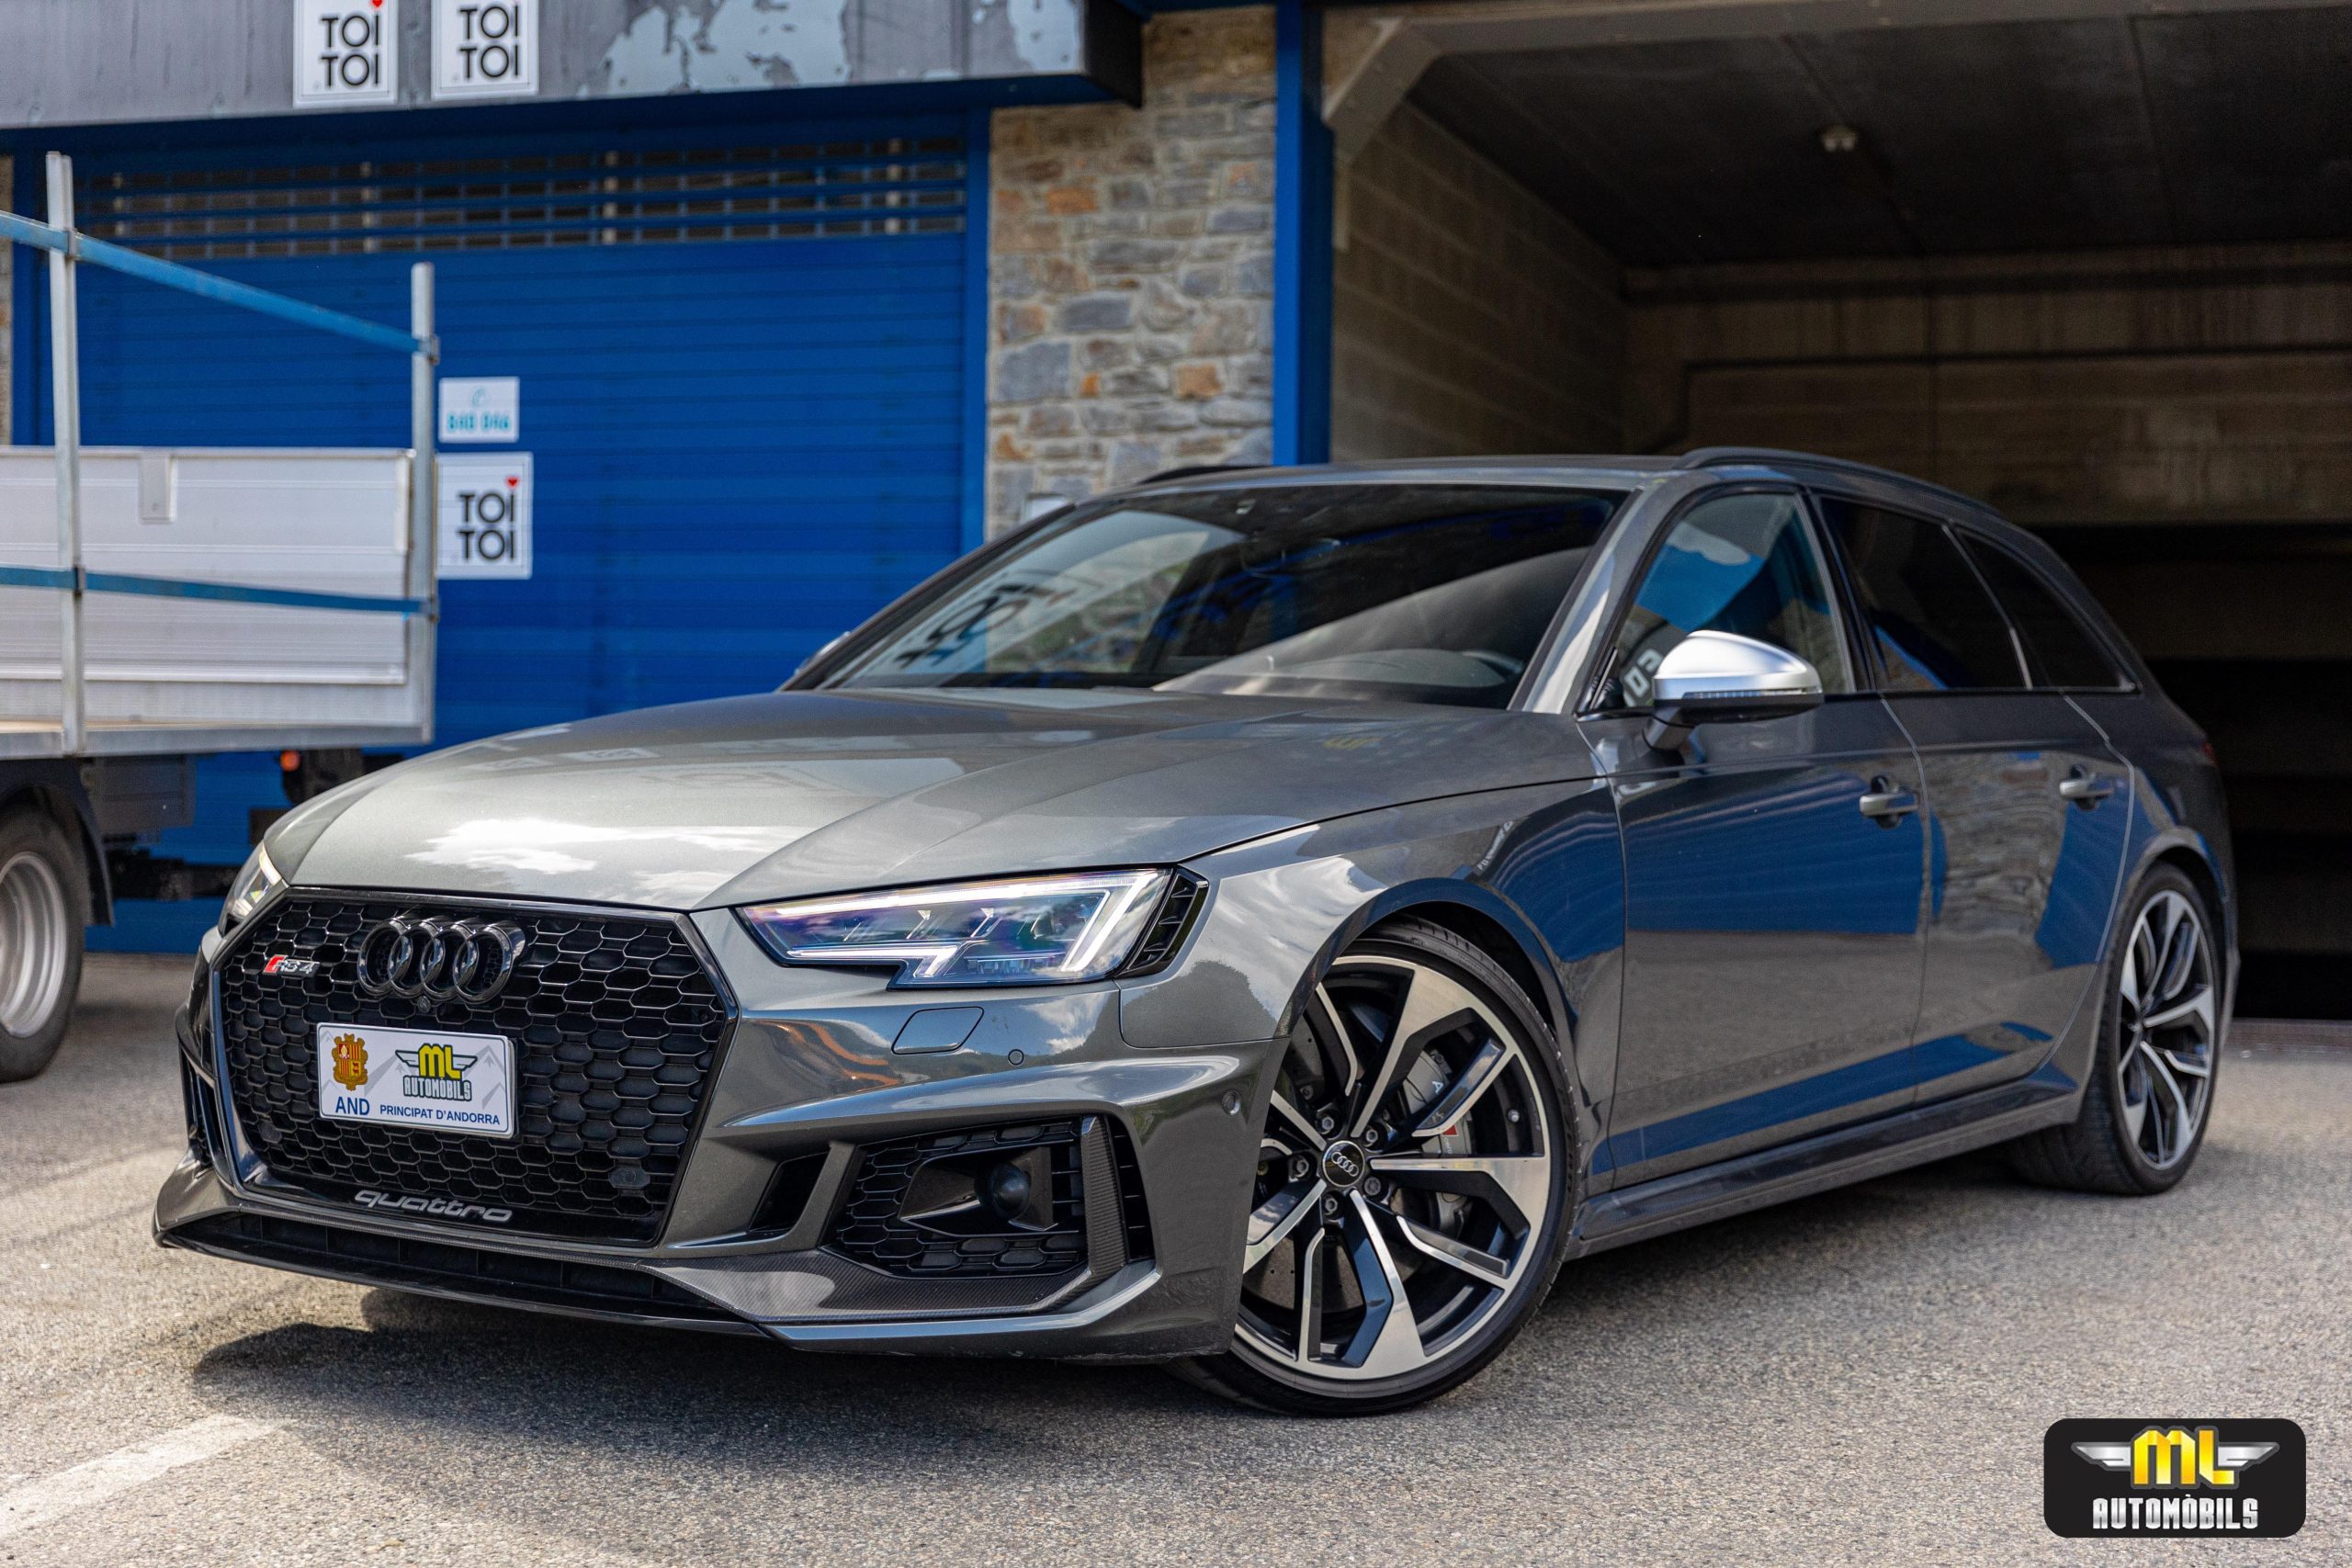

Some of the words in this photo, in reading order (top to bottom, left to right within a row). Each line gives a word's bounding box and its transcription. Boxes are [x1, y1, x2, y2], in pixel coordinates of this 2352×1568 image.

[320, 14, 380, 48] TOI
[458, 5, 519, 40] TOI
[320, 52, 380, 87] TOI
[458, 44, 519, 79] TOI
[457, 491, 515, 525] TOI
[456, 528, 514, 561] TOI
[418, 1043, 462, 1079] ML
[335, 1096, 370, 1116] AND
[379, 1104, 434, 1120] PRINCIPAT
[435, 1110, 501, 1125] D'ANDORRA
[354, 1189, 513, 1223] quattro
